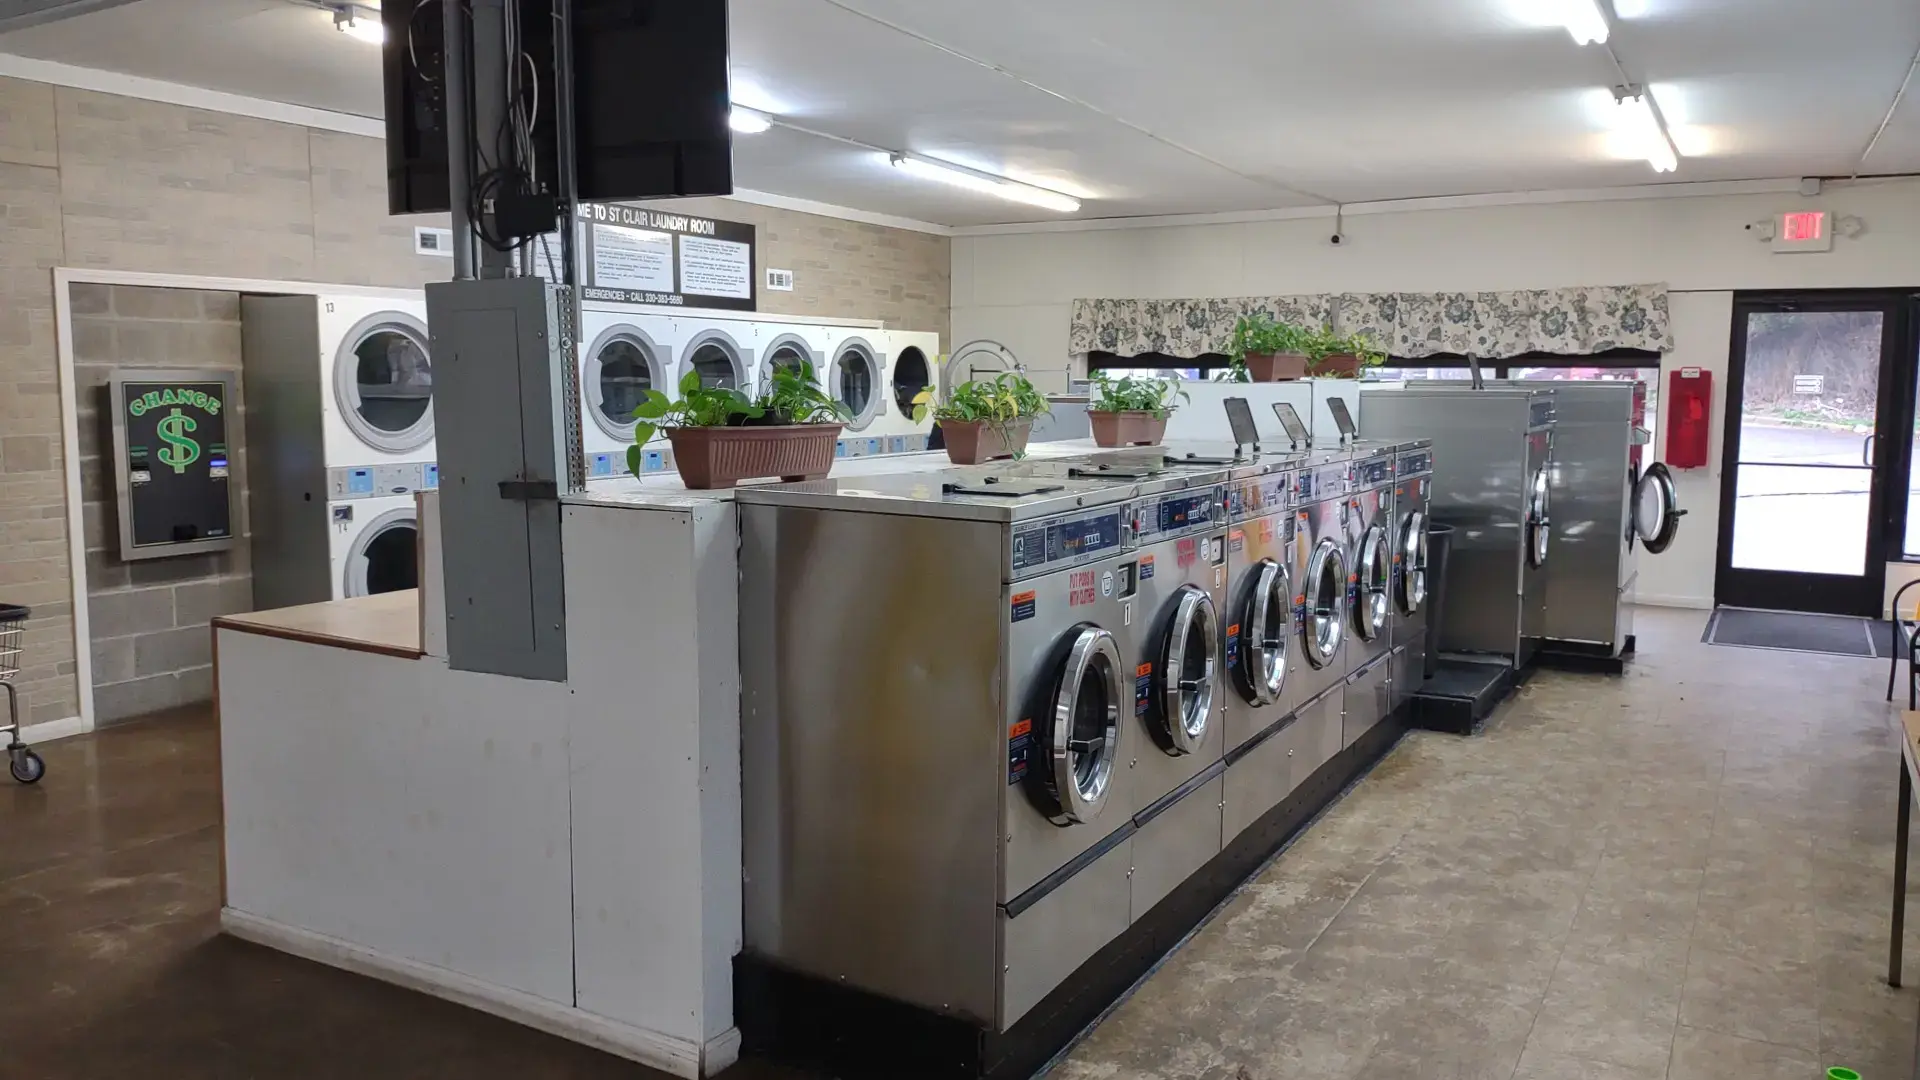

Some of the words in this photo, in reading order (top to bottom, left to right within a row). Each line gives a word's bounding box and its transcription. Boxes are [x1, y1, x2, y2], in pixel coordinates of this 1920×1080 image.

[594, 204, 606, 221] TO
[609, 205, 621, 222] ST
[623, 208, 648, 226] CLAIR
[650, 212, 689, 231] LAUNDRY
[690, 219, 715, 235] ROOM
[1784, 212, 1824, 240] EXIT
[325, 302, 335, 314] 13
[585, 288, 625, 301] EMERGENCIES
[631, 292, 644, 302] CALL
[129, 388, 221, 416] CHANGE
